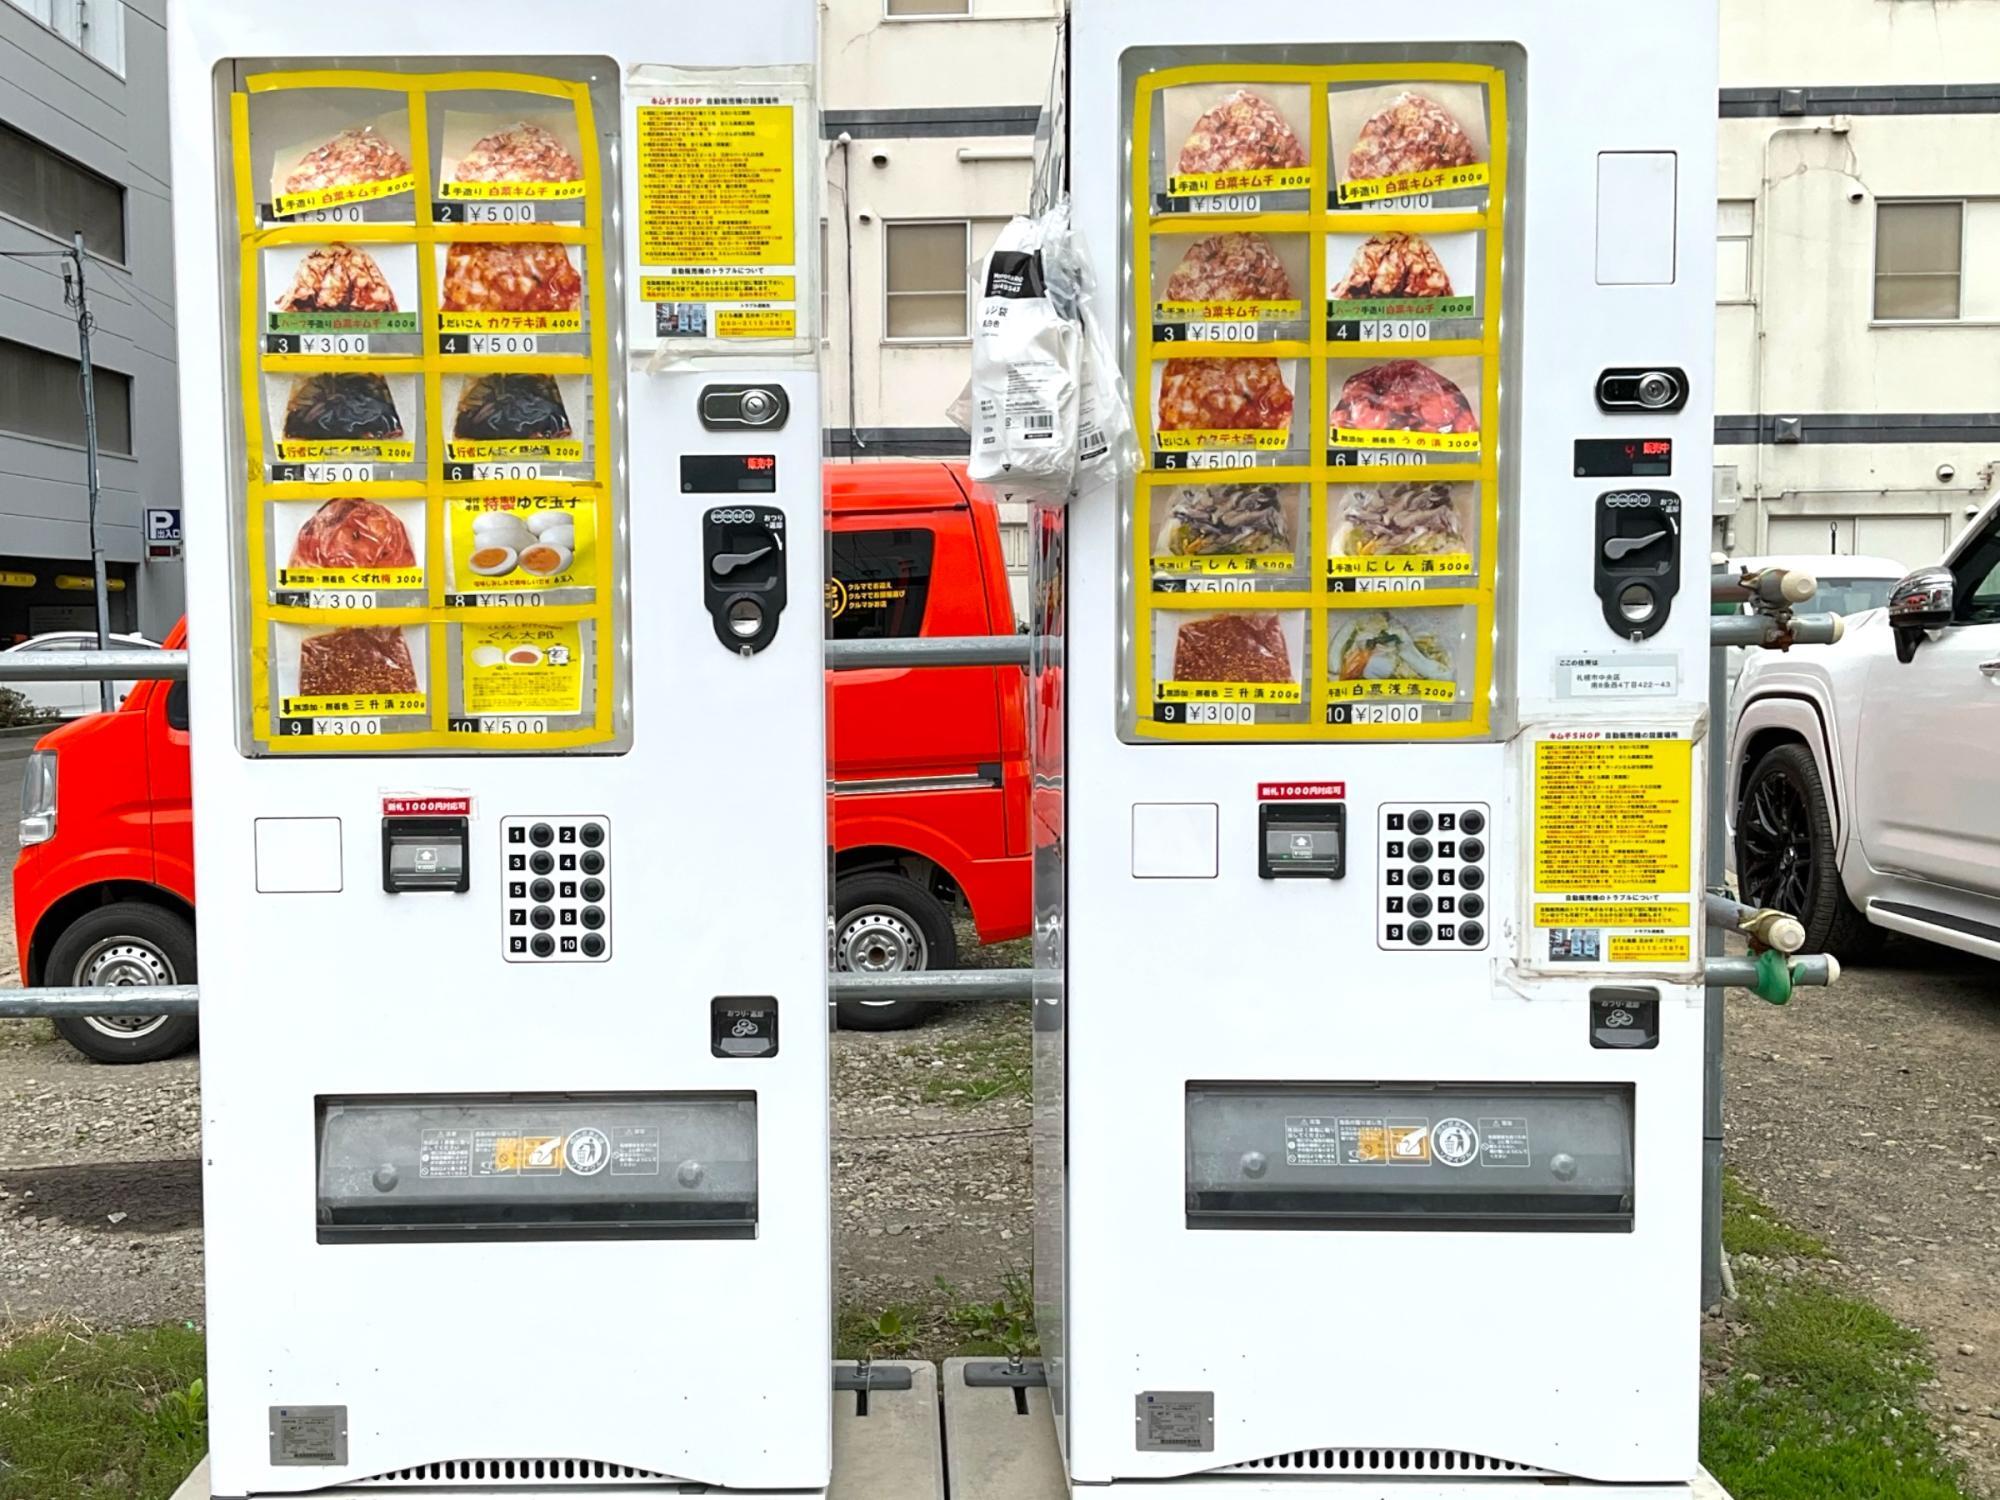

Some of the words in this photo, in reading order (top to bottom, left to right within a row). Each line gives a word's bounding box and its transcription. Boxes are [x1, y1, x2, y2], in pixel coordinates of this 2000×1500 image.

[1178, 181, 1208, 192] 手造り
[1214, 175, 1275, 189] 白菜キムチ
[1350, 185, 1379, 198] 手造り
[1386, 174, 1445, 193] 白菜キムチ
[285, 197, 316, 209] 手造り
[322, 185, 381, 203] 白菜キムチ
[453, 187, 482, 196] 手造り
[489, 186, 548, 196] 白菜キムチ
[440, 206, 451, 221] 2
[469, 206, 531, 221] ¥500
[671, 267, 765, 275] 自動販売機のトラブルについて
[1203, 305, 1260, 318] 白菜キムチ
[447, 319, 482, 328] だいこん
[488, 317, 548, 328] カクテキ漬
[1164, 327, 1174, 342] 3
[1192, 325, 1255, 341] ¥500
[1336, 324, 1348, 339] 4
[1363, 323, 1426, 339] ¥300
[277, 338, 289, 353] 3
[303, 337, 364, 353] ¥300
[444, 338, 456, 353] 4
[473, 337, 533, 352] ¥500
[1166, 455, 1176, 469] 5
[1191, 454, 1252, 469] ¥500
[1335, 453, 1346, 467] 6
[1361, 452, 1423, 466] ¥500
[283, 468, 294, 481] 5
[308, 467, 369, 482] ¥500
[451, 467, 462, 481] 6
[477, 466, 537, 481] ¥500
[150, 511, 174, 539] P
[1335, 563, 1361, 573] 手造り
[1367, 560, 1434, 572] にしん漬
[1334, 581, 1344, 593] 8
[1359, 580, 1421, 592] ¥500
[288, 596, 298, 607] 7
[313, 594, 372, 609] ¥300
[455, 595, 465, 607] 8
[480, 594, 540, 607] ¥500
[488, 631, 555, 640] くん太郎
[1224, 688, 1264, 698] 三升漬
[354, 699, 394, 710] 三升漬
[1164, 706, 1175, 721] 9
[1190, 706, 1251, 721] ¥300
[1327, 707, 1345, 722] 10
[1355, 707, 1418, 722] ¥200
[291, 721, 302, 736] 9
[317, 720, 377, 735] ¥300
[452, 721, 472, 732] 10
[483, 720, 543, 734] ¥500
[1393, 818, 1397, 826] 1
[1444, 817, 1450, 826] 2
[515, 831, 519, 839] 1
[564, 831, 570, 840] 2
[1392, 845, 1398, 854] 3
[1443, 845, 1449, 853] 4
[514, 858, 520, 867] 3
[565, 859, 571, 867] 4
[1392, 872, 1398, 881] 5
[1443, 873, 1450, 882] 6
[515, 885, 521, 894] 5
[565, 886, 571, 895] 6
[1392, 900, 1398, 909] 7
[1443, 900, 1449, 909] 8
[515, 913, 521, 922] 7
[565, 913, 571, 922] 8
[1392, 928, 1399, 937] 9
[1441, 926, 1455, 938] 10
[515, 940, 521, 949] 9
[564, 940, 575, 949] 10
